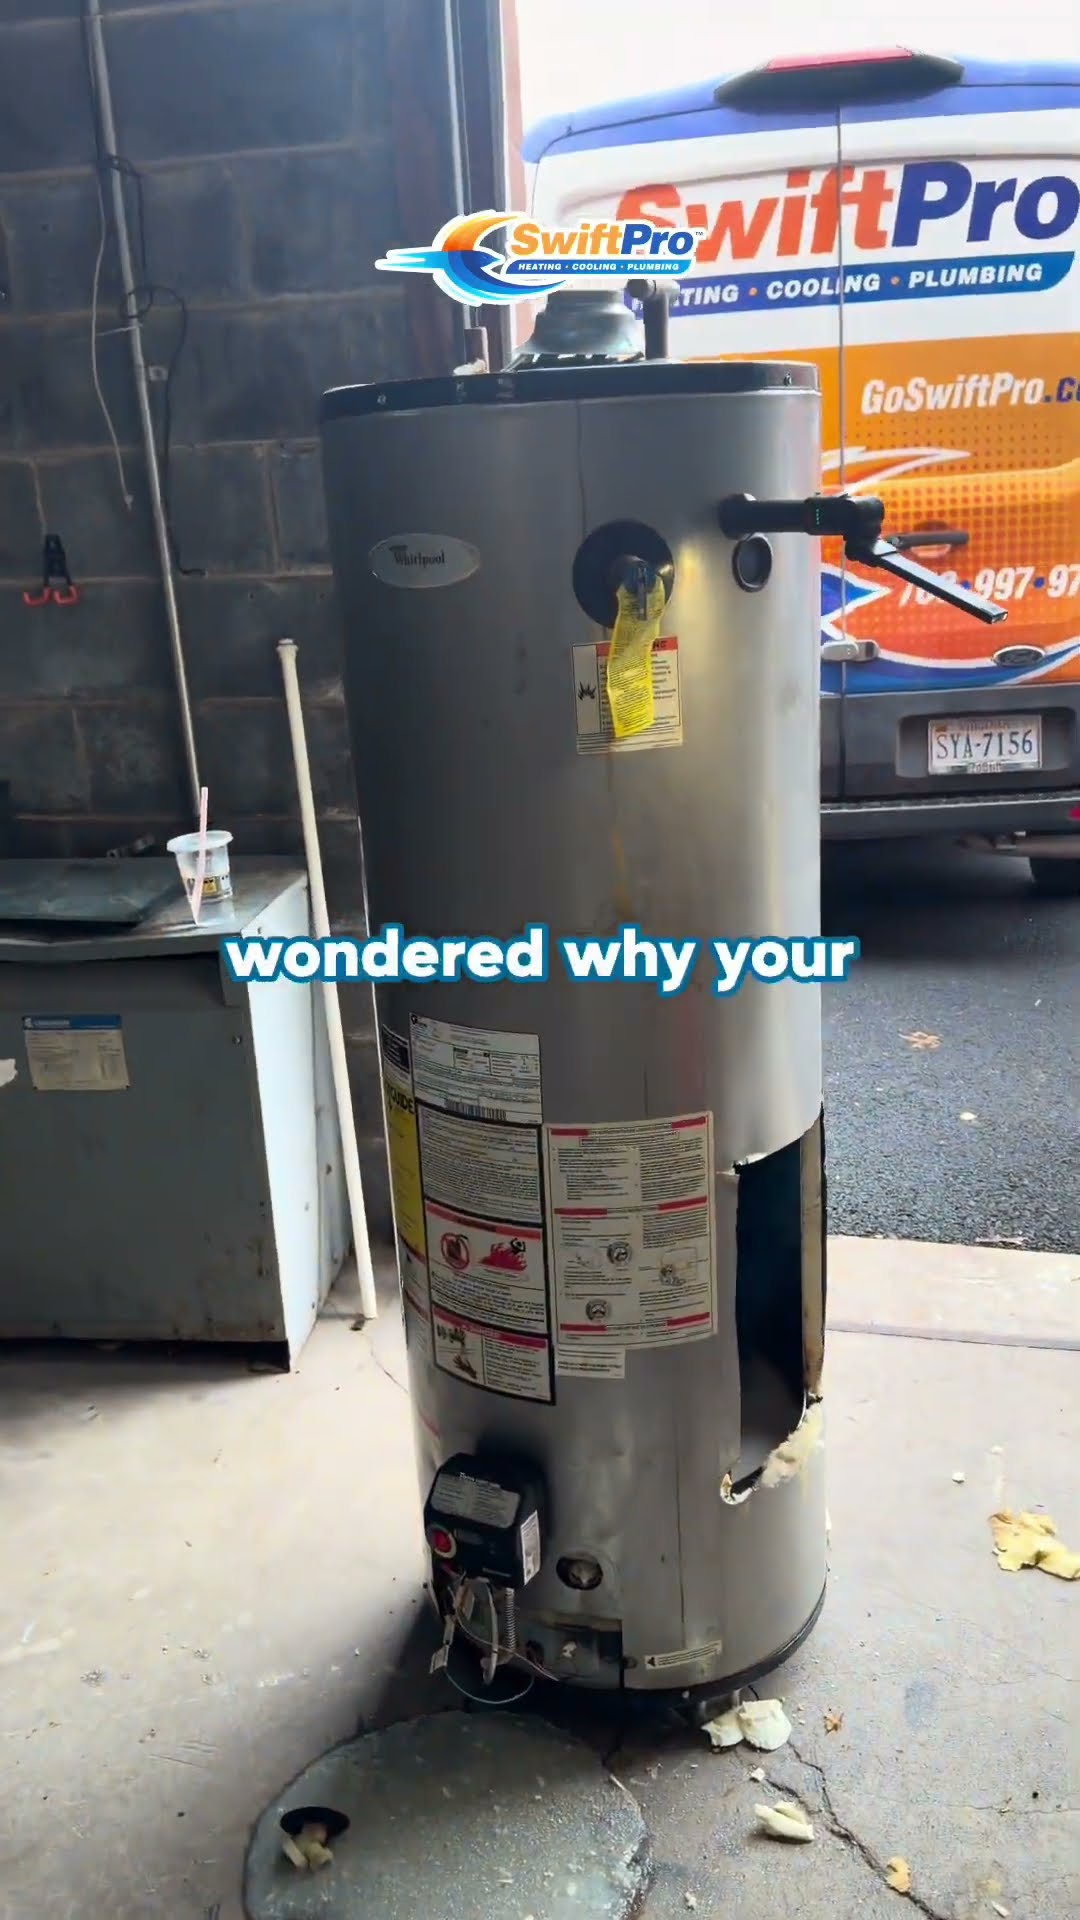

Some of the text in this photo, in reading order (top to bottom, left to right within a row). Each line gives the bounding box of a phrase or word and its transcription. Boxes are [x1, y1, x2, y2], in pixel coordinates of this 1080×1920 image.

[616, 161, 1080, 262] SwiftPro
[766, 272, 880, 300] COOLING
[908, 263, 1043, 289] PLUMBING
[861, 372, 1080, 415] GoSwiftPro.c
[936, 728, 1033, 760] SYA-7156
